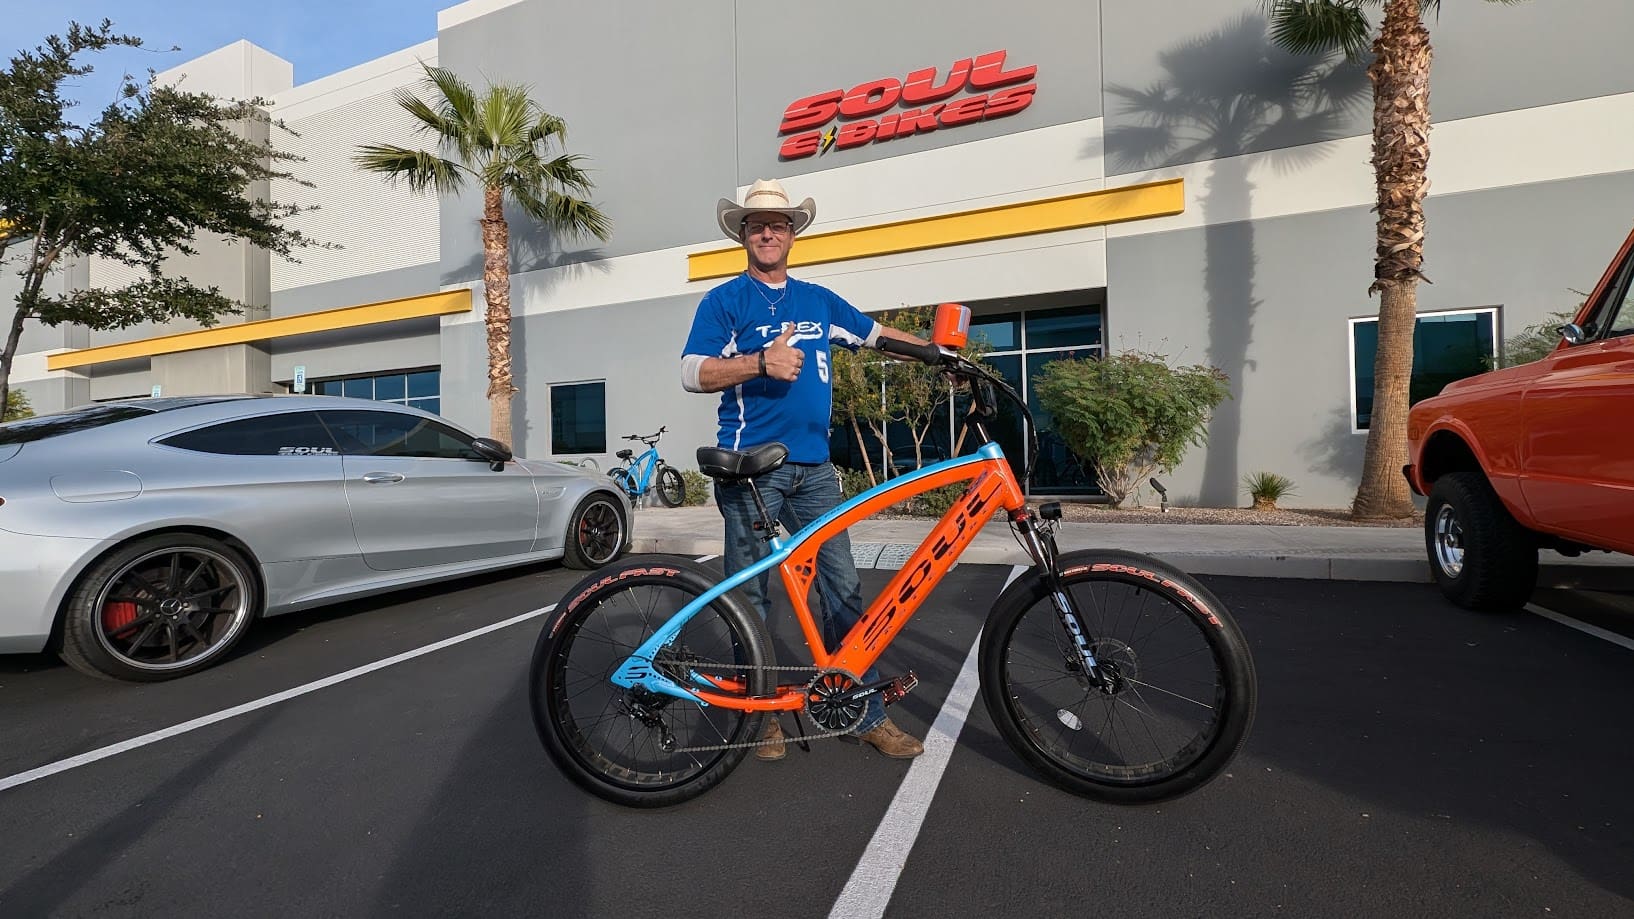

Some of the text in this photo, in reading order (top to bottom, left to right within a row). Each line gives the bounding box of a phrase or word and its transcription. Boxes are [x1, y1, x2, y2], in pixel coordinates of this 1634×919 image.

[779, 50, 1037, 133] SOUL
[816, 349, 829, 384] 5
[278, 446, 340, 454] SOUL
[863, 482, 1002, 652] SOUL
[1091, 563, 1161, 583] SOUL
[567, 567, 681, 613] SOUL FAST
[1053, 592, 1097, 679] SOUL
[852, 688, 878, 700] SOUL
